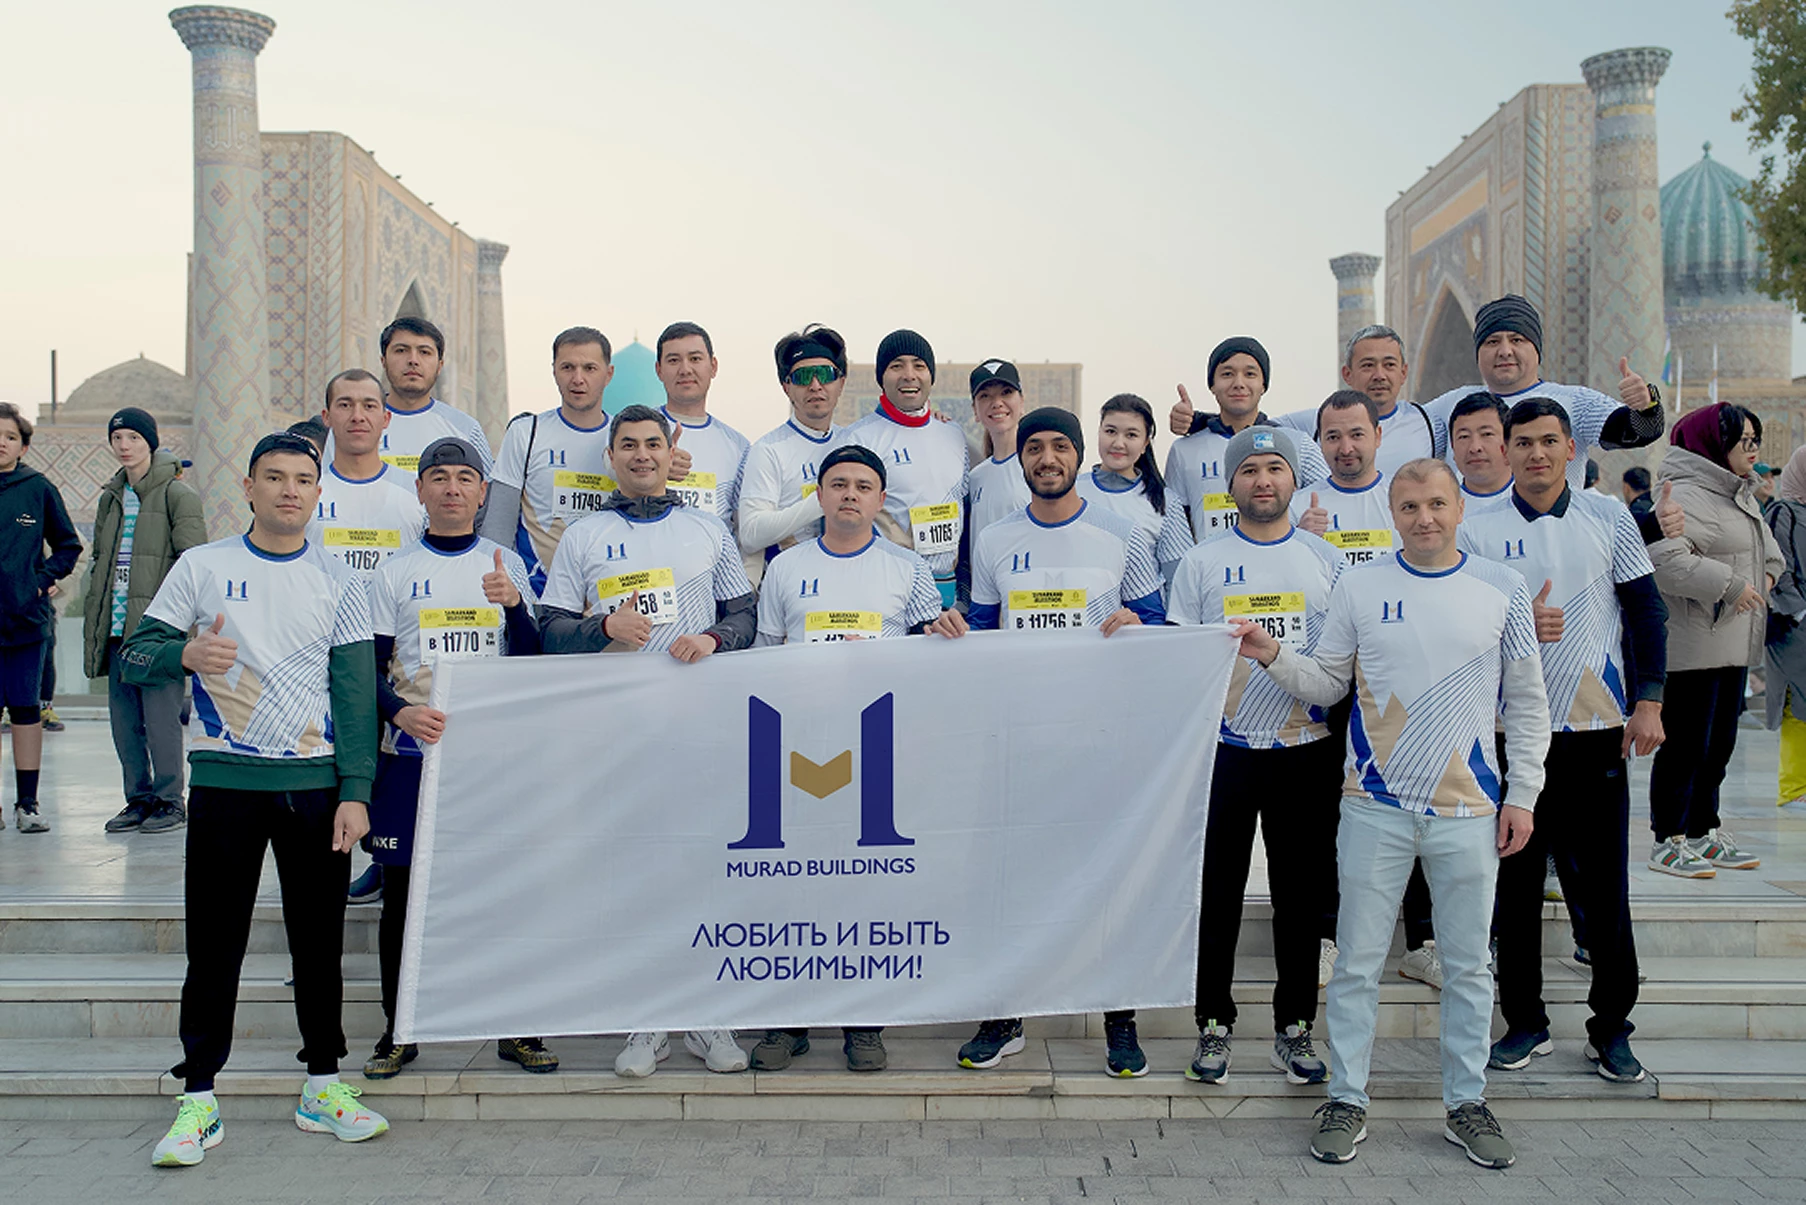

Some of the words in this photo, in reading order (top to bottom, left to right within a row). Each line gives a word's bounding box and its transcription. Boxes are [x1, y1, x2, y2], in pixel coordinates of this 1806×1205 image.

[571, 492, 601, 511] 11749
[1212, 517, 1218, 527] B
[429, 637, 437, 650] B
[442, 631, 479, 652] 11770
[727, 860, 802, 878] MURAD
[807, 857, 916, 877] BUILDINGS
[692, 922, 827, 948] ЛЮБИТЬ
[837, 921, 859, 947] И
[869, 920, 951, 946] БЫТЬ
[716, 954, 923, 982] ЛЮБИМЫМИ!
